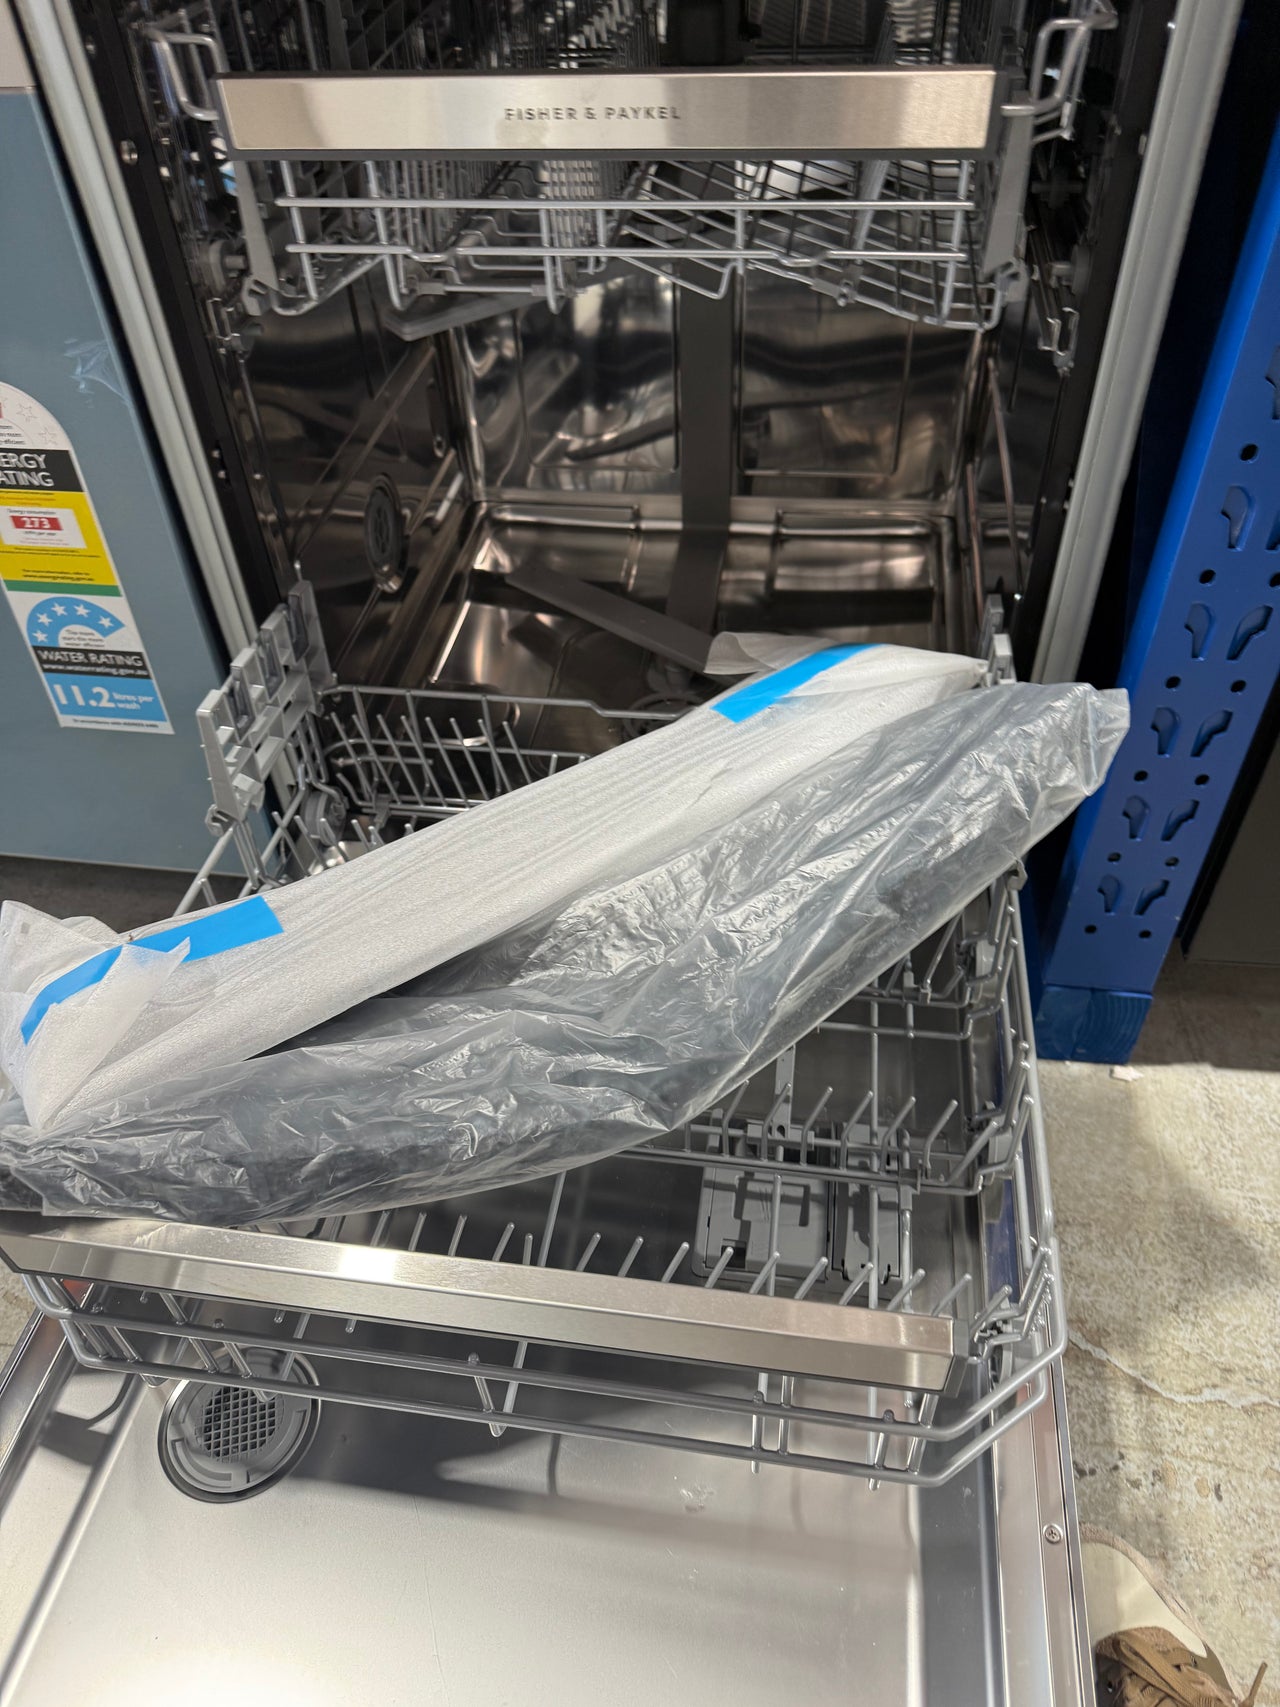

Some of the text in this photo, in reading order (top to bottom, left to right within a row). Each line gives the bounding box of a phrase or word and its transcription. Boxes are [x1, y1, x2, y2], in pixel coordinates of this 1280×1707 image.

[504, 106, 681, 120] FISHER & PAYKEL
[20, 517, 51, 529] 273
[37, 650, 143, 667] WATER RATING
[53, 684, 116, 708] 11.2
